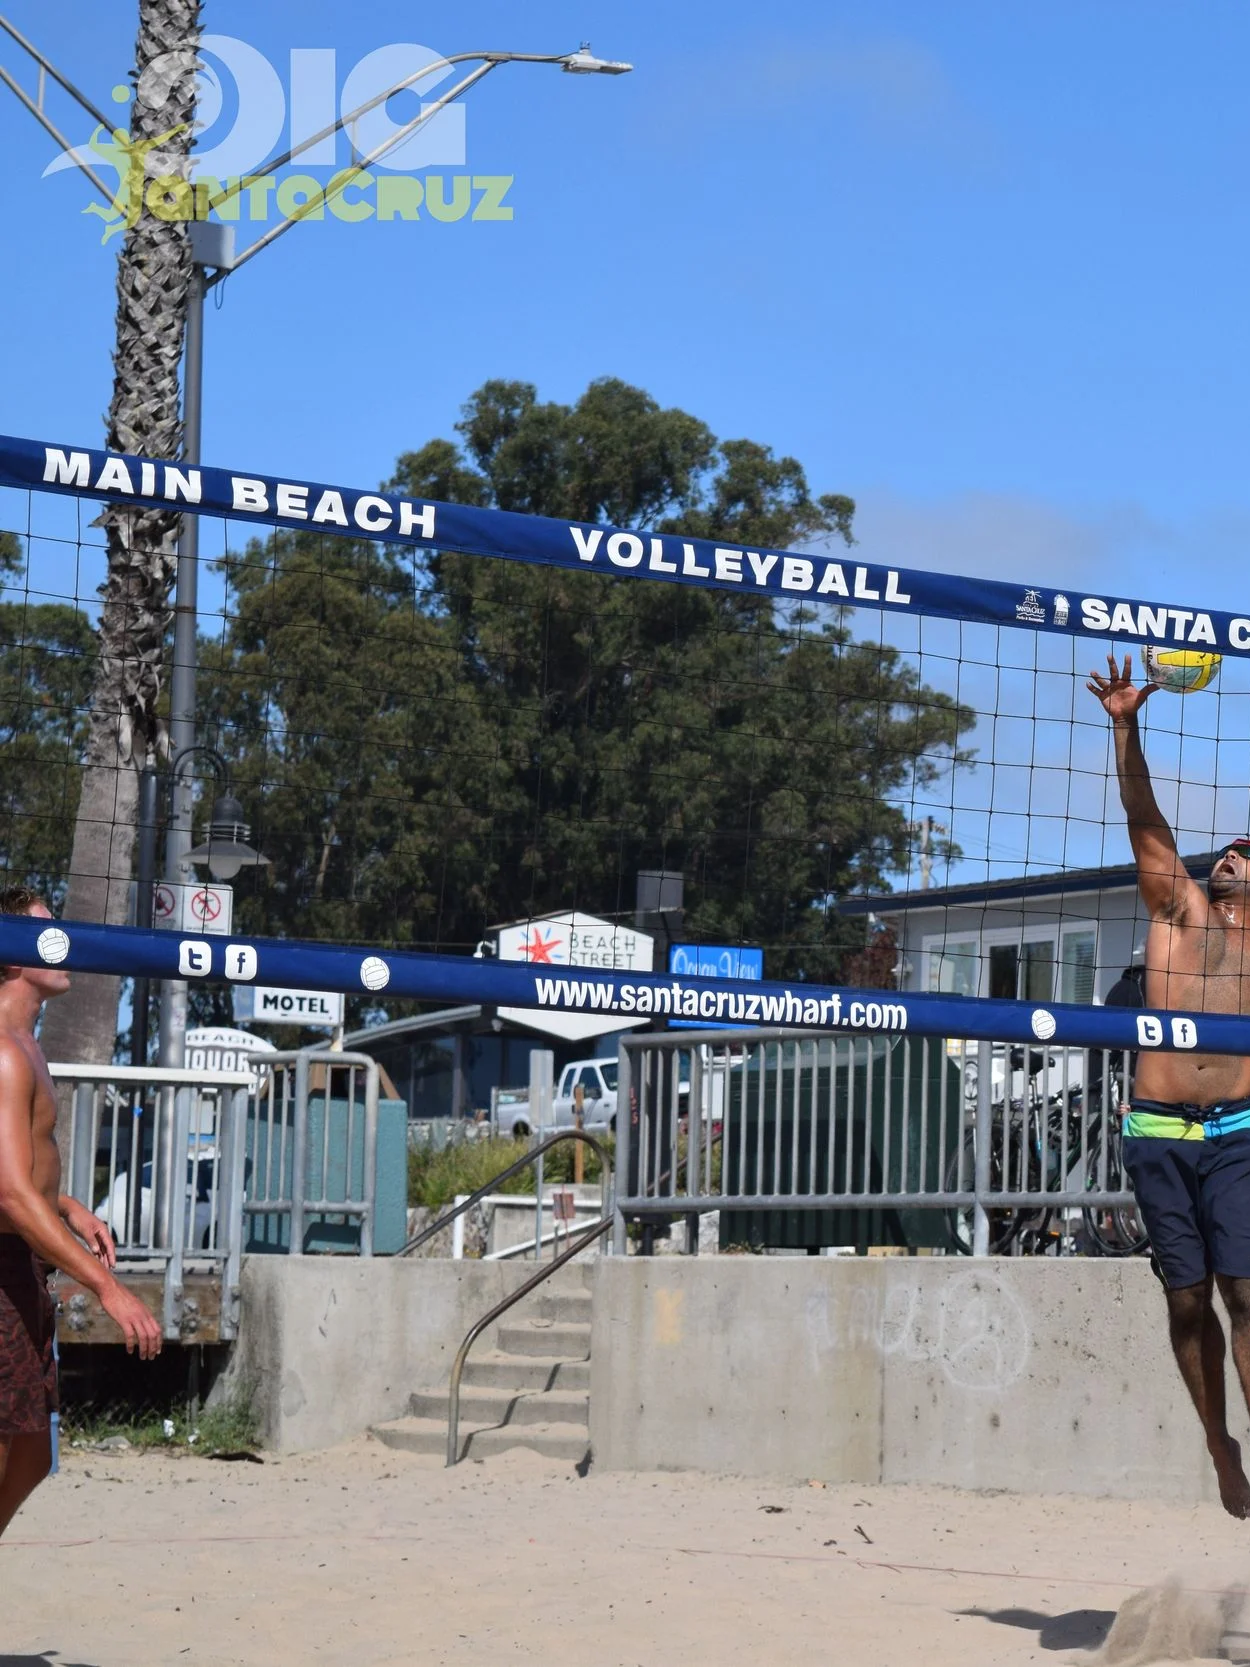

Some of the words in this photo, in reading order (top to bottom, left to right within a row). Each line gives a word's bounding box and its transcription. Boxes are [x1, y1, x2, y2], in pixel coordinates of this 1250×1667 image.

[43, 447, 201, 504] MAIN
[231, 477, 436, 539] BEACH
[569, 526, 912, 605] VOLLEYBALL
[1080, 597, 1217, 646] SANTA
[570, 932, 636, 950] BEACH
[570, 950, 636, 970] STREET
[262, 994, 330, 1014] MOTEL
[534, 977, 908, 1030] www.santacruzwharf.com
